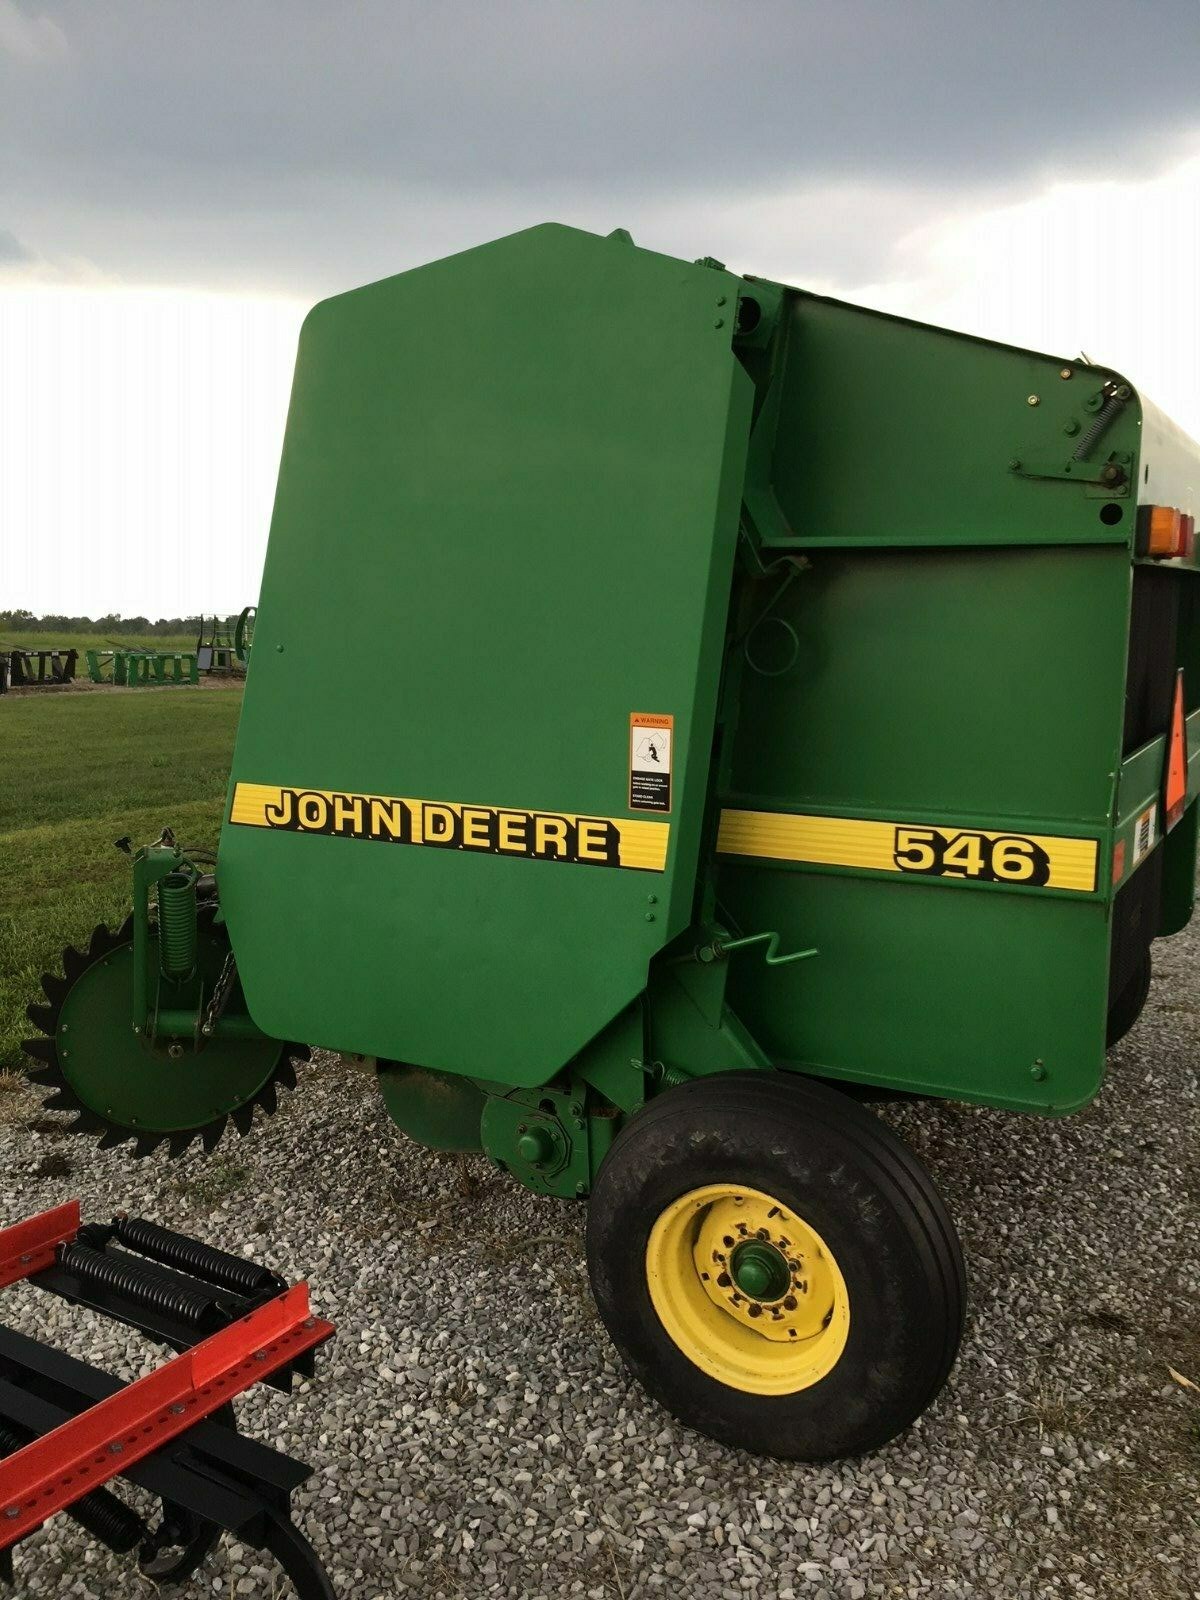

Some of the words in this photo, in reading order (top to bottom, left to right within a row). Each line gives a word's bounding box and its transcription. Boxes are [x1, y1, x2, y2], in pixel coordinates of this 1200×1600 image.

[641, 717, 669, 725] WARNING
[265, 790, 403, 842] JOHN
[422, 803, 612, 863] DEERE
[895, 828, 1040, 883] 546
